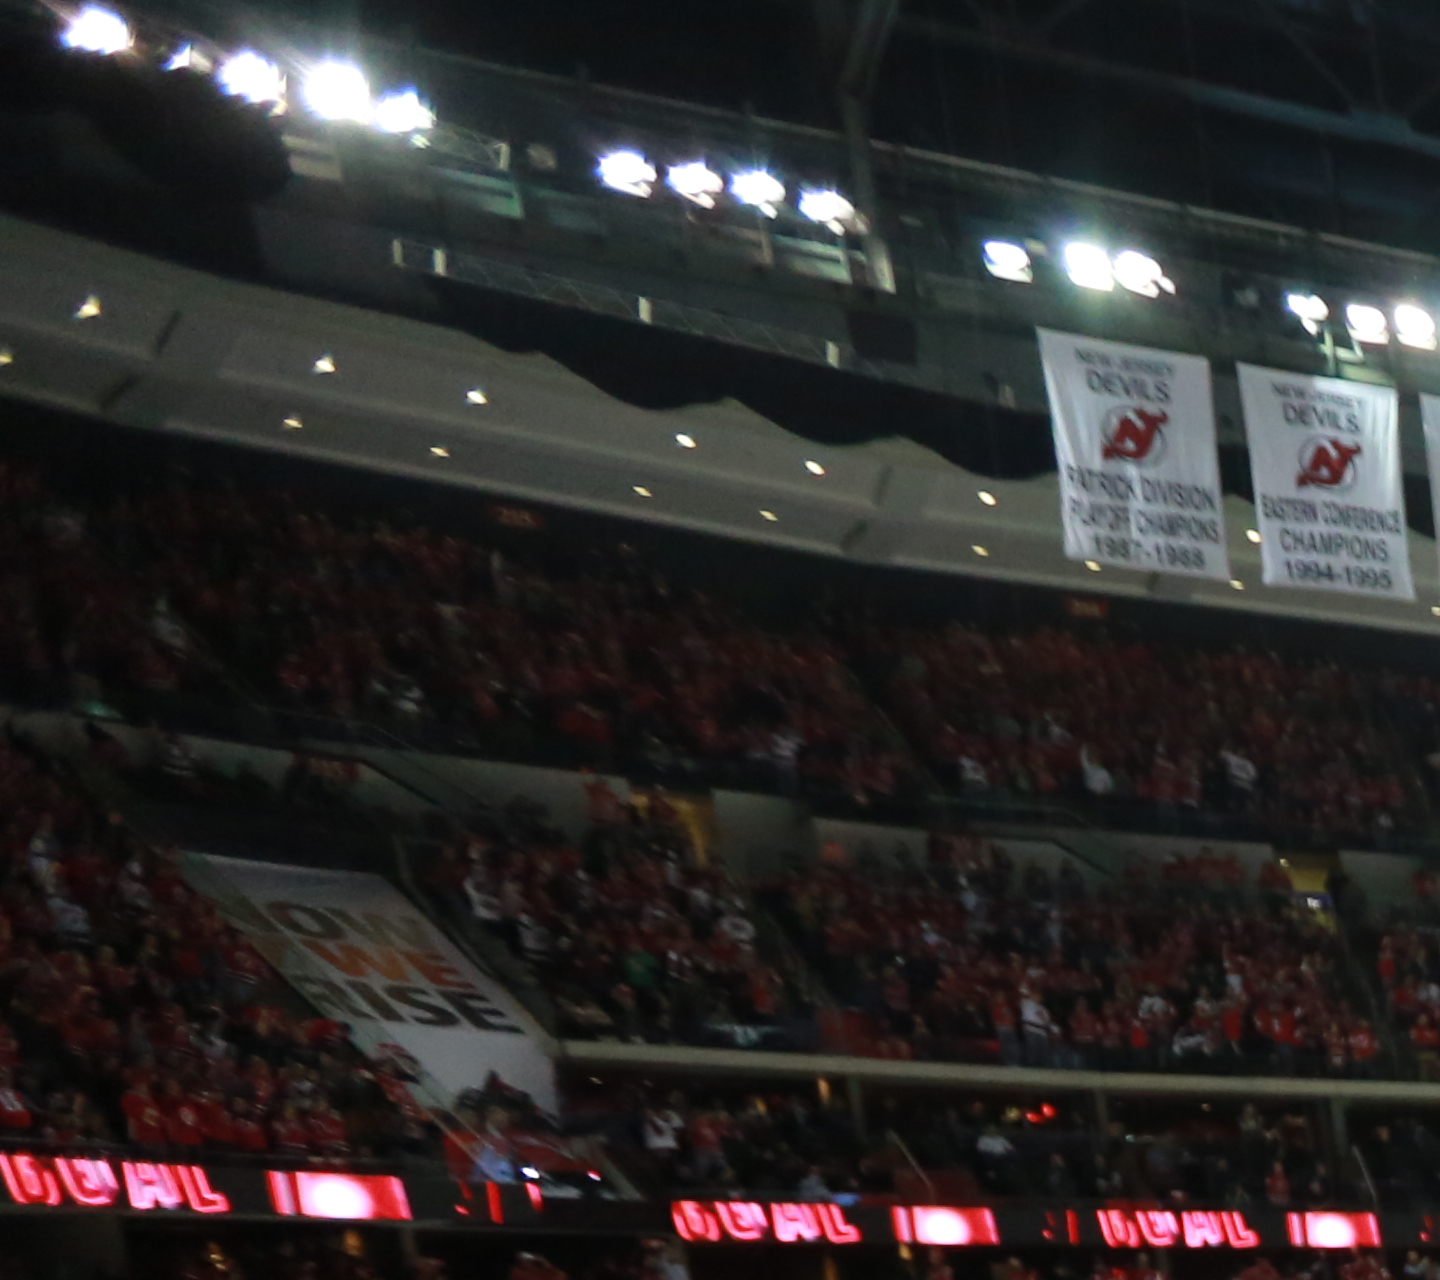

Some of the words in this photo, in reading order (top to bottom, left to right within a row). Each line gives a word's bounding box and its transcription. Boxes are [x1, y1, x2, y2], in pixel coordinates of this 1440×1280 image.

[1087, 371, 1171, 403] DEVILS
[1283, 401, 1361, 433] DEVILS
[1065, 465, 1134, 499] PATRICK
[1141, 479, 1216, 512] DIVISION
[1136, 508, 1220, 543] CHAMPIONS
[1261, 495, 1318, 522] EASTERN
[1321, 500, 1402, 533] CONFERENCE
[1279, 529, 1389, 562] CHAMPIONS
[1285, 560, 1394, 590] 1994-1995
[288, 974, 525, 1036] RISE
